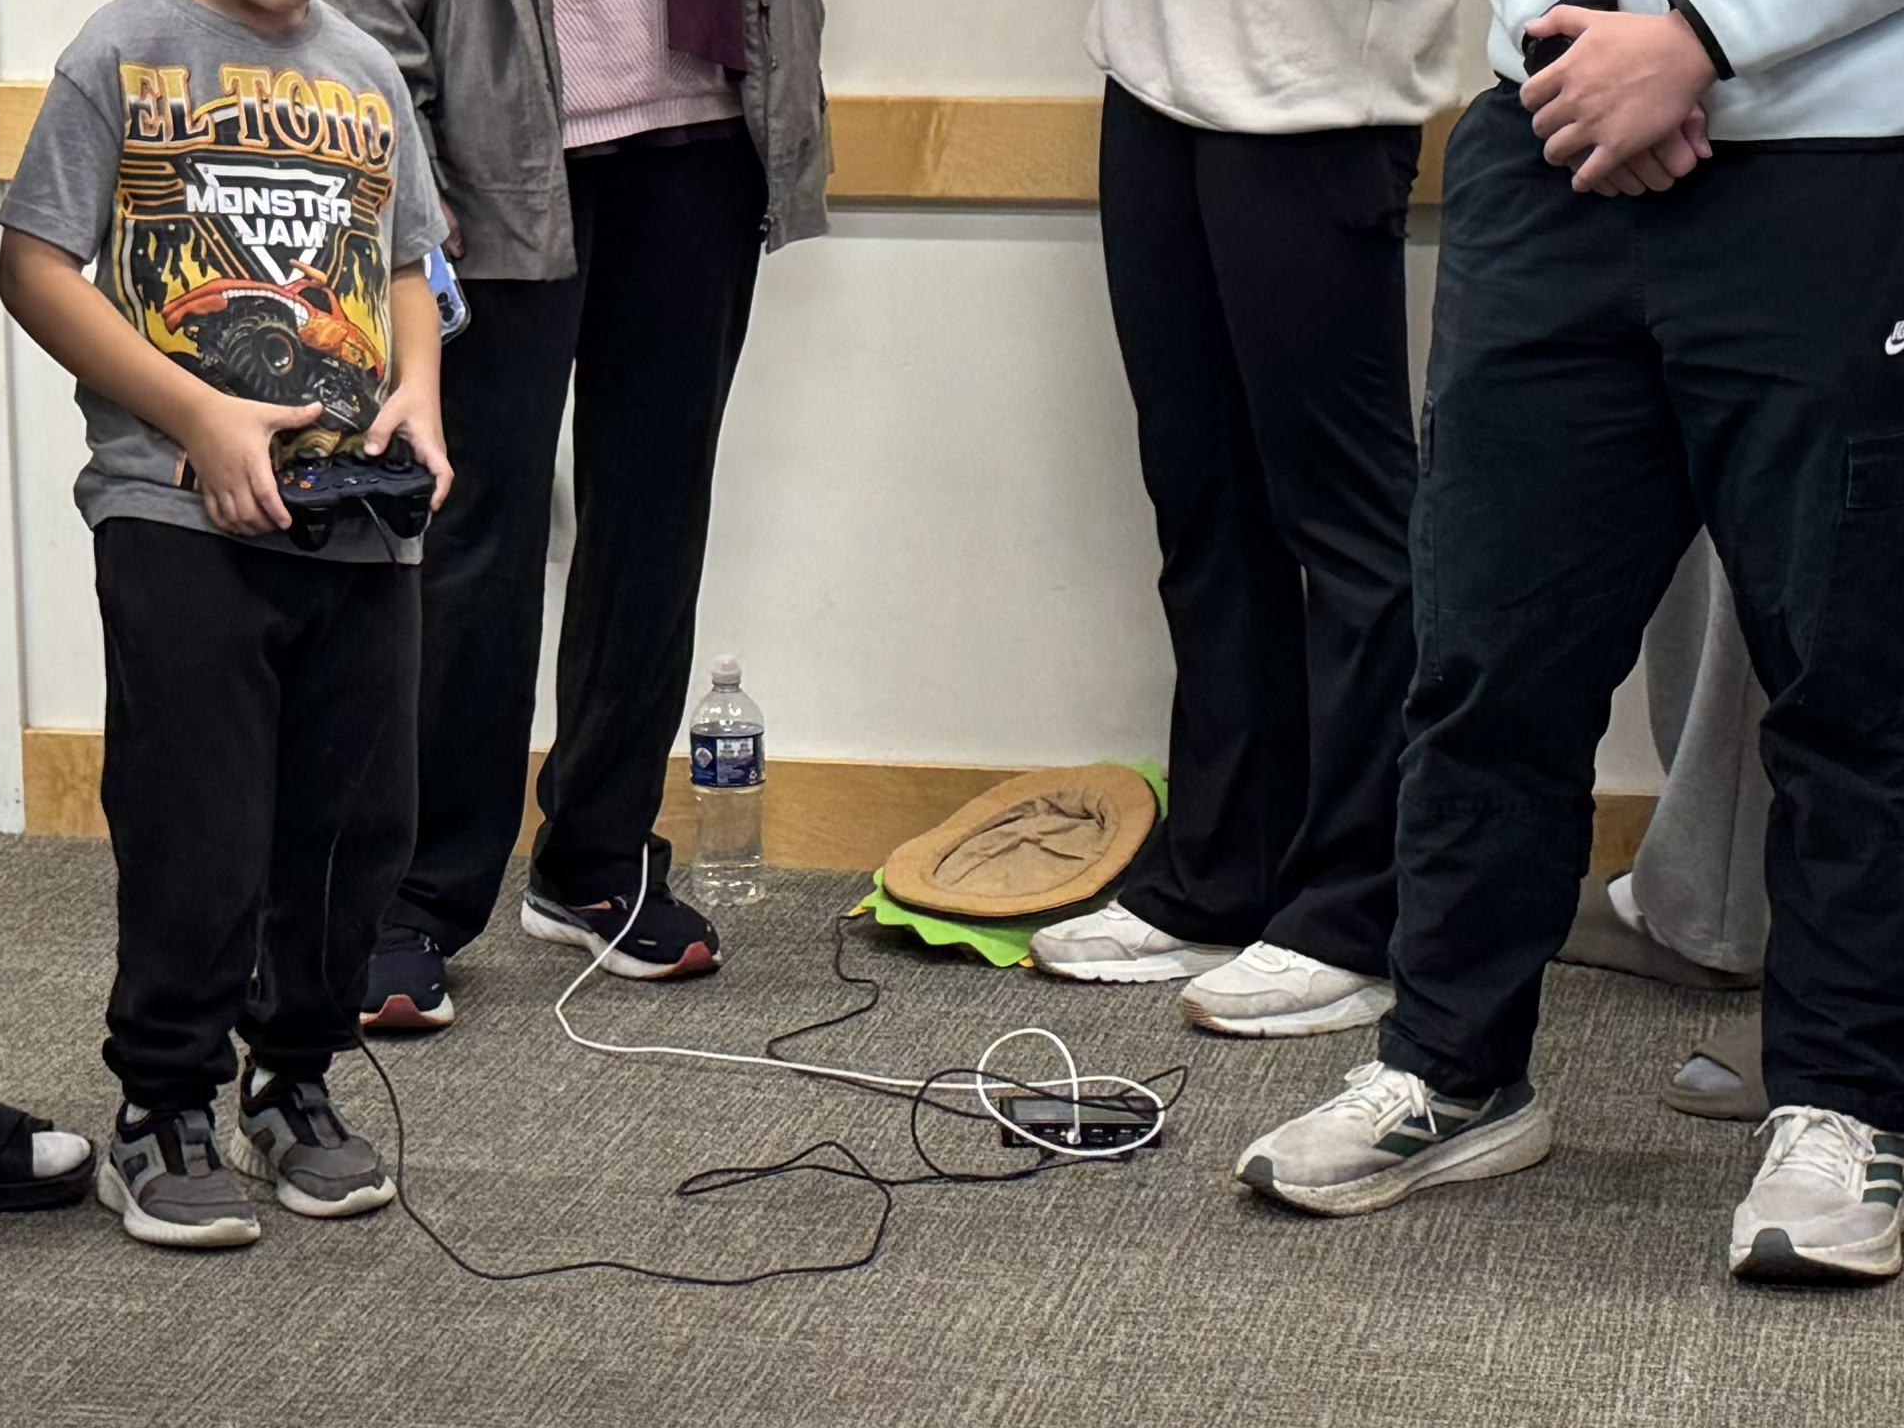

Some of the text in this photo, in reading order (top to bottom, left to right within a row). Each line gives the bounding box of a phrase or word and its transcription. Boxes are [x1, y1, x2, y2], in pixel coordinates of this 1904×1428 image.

[119, 60, 396, 173] EL TORO
[185, 183, 352, 227] MONSTER
[241, 216, 327, 249] JAM
